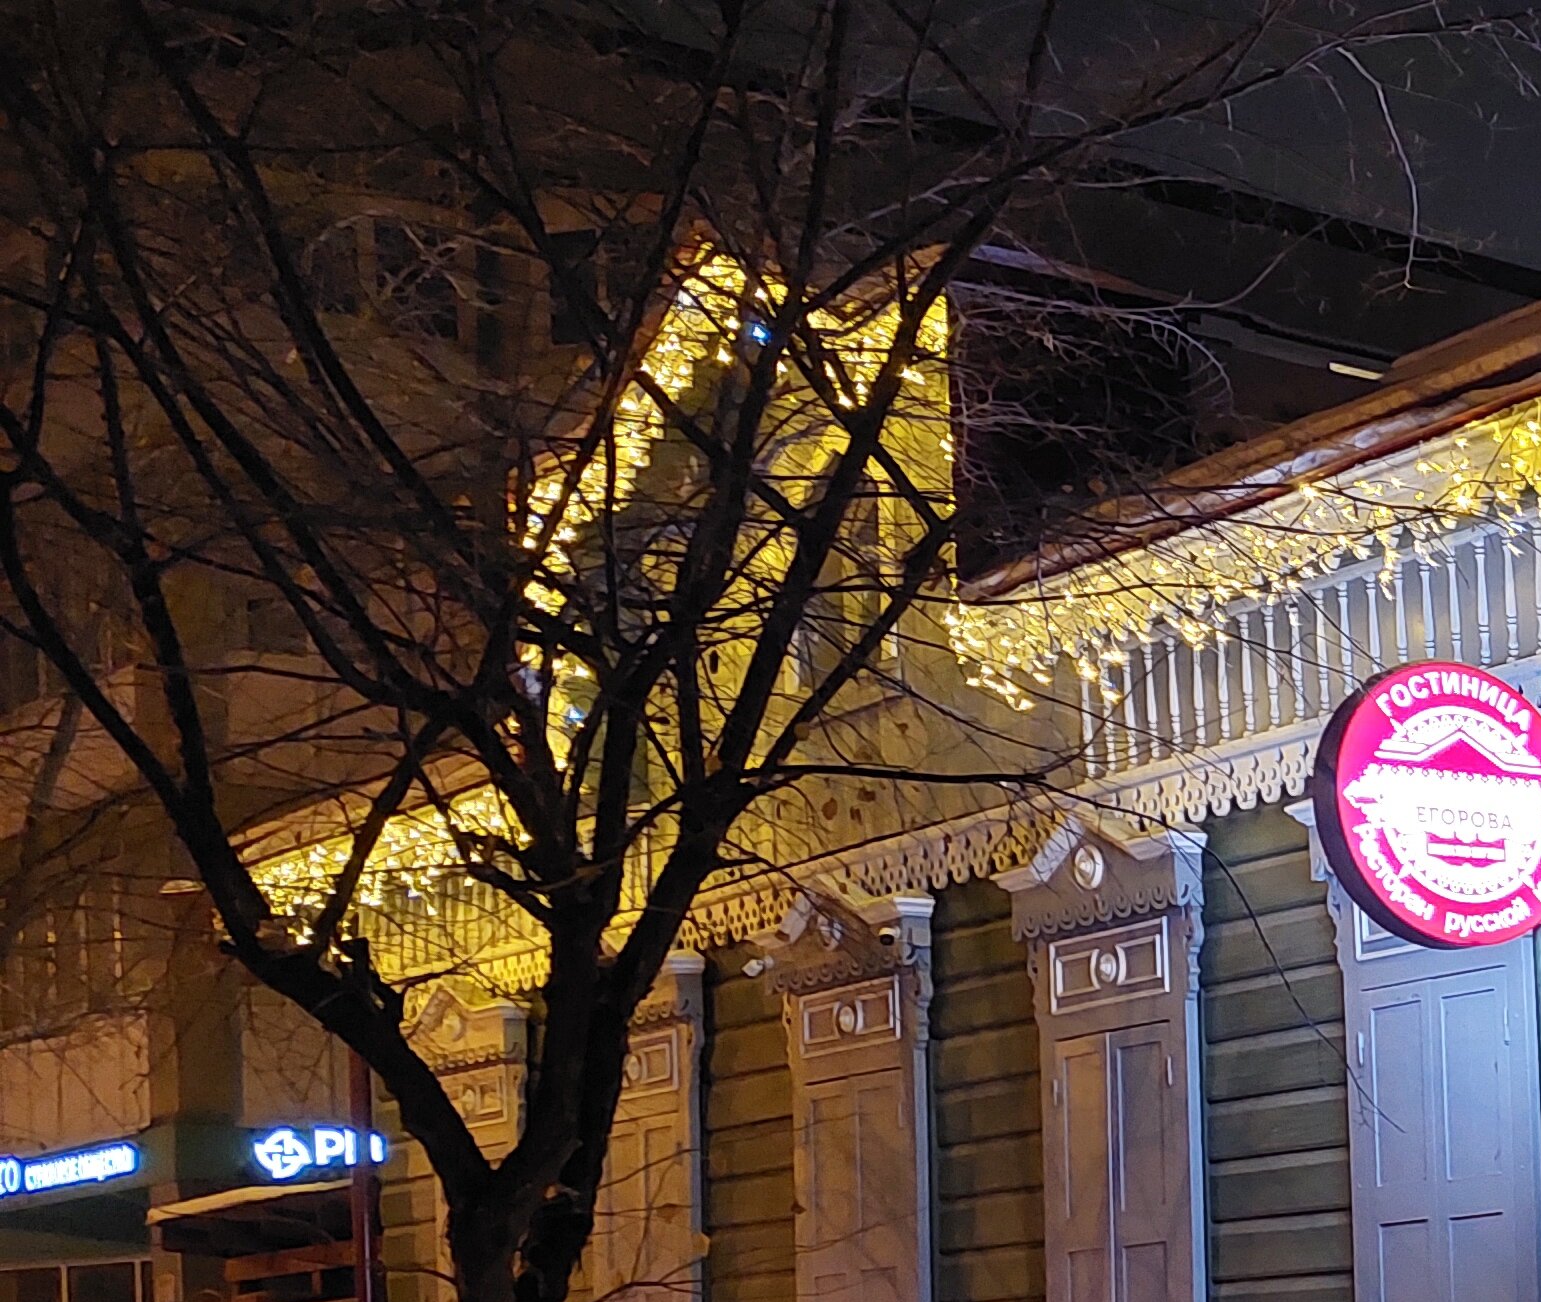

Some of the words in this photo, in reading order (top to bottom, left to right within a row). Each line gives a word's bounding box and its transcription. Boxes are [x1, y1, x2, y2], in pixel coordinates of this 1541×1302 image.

[1376, 671, 1532, 732] ГОСТИНИЦА
[1416, 805, 1513, 831] ЕГОРОВА
[1444, 896, 1531, 938] русской
